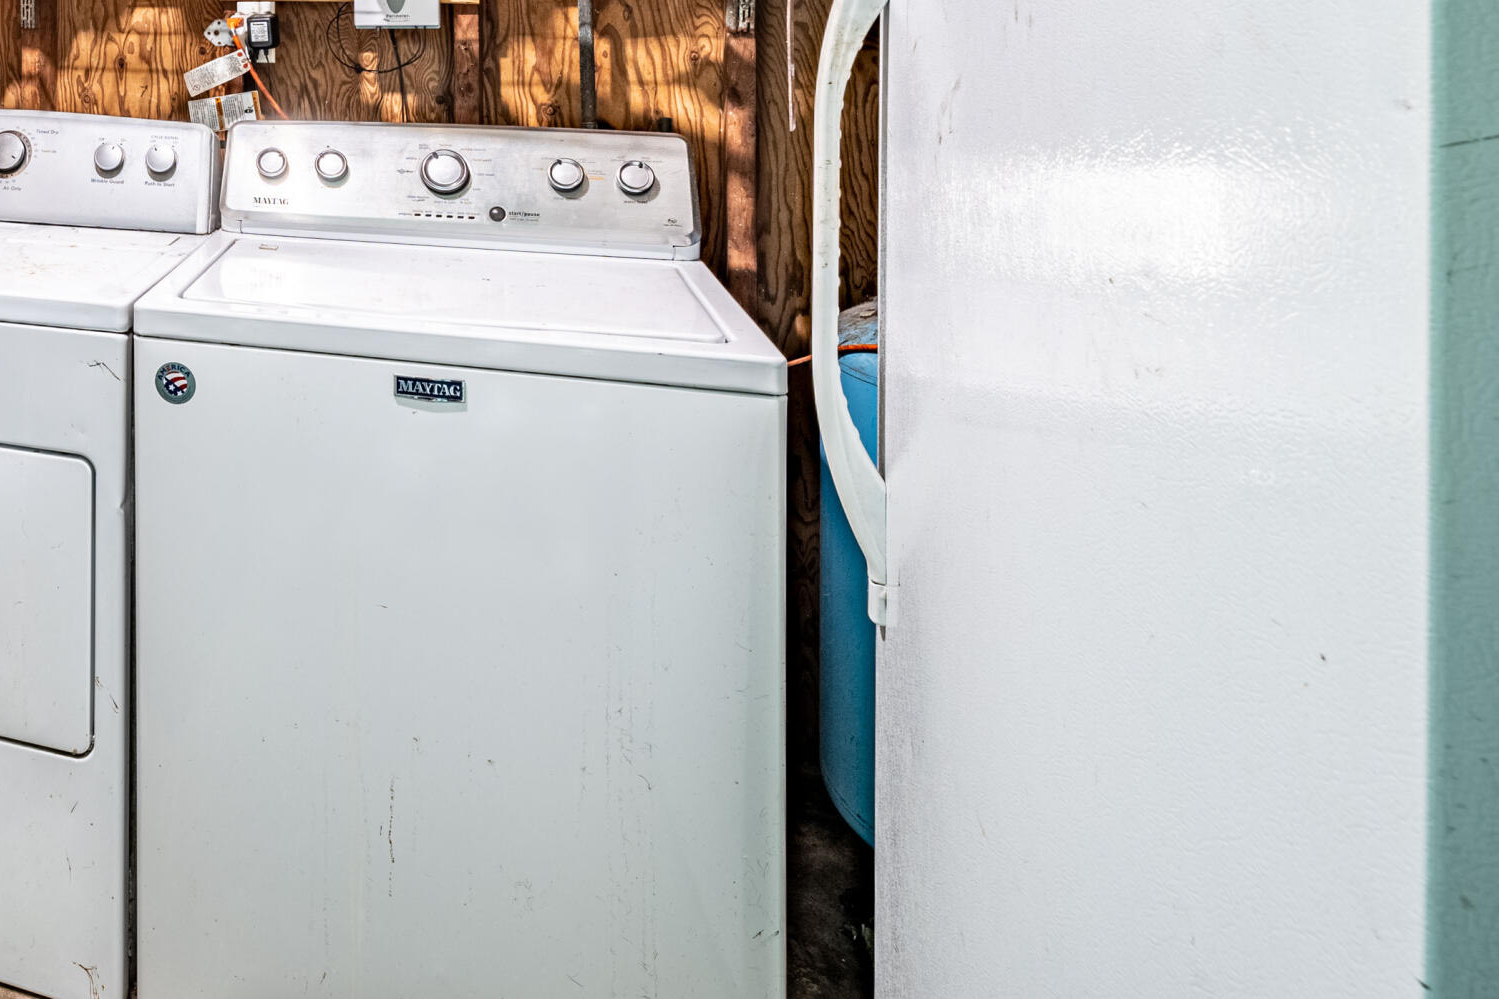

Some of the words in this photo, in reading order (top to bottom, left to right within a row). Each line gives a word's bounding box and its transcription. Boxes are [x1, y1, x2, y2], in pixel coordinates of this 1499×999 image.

[253, 196, 289, 206] MAYTAG
[157, 364, 191, 381] AMERICA
[398, 379, 461, 397] MAYTAG
